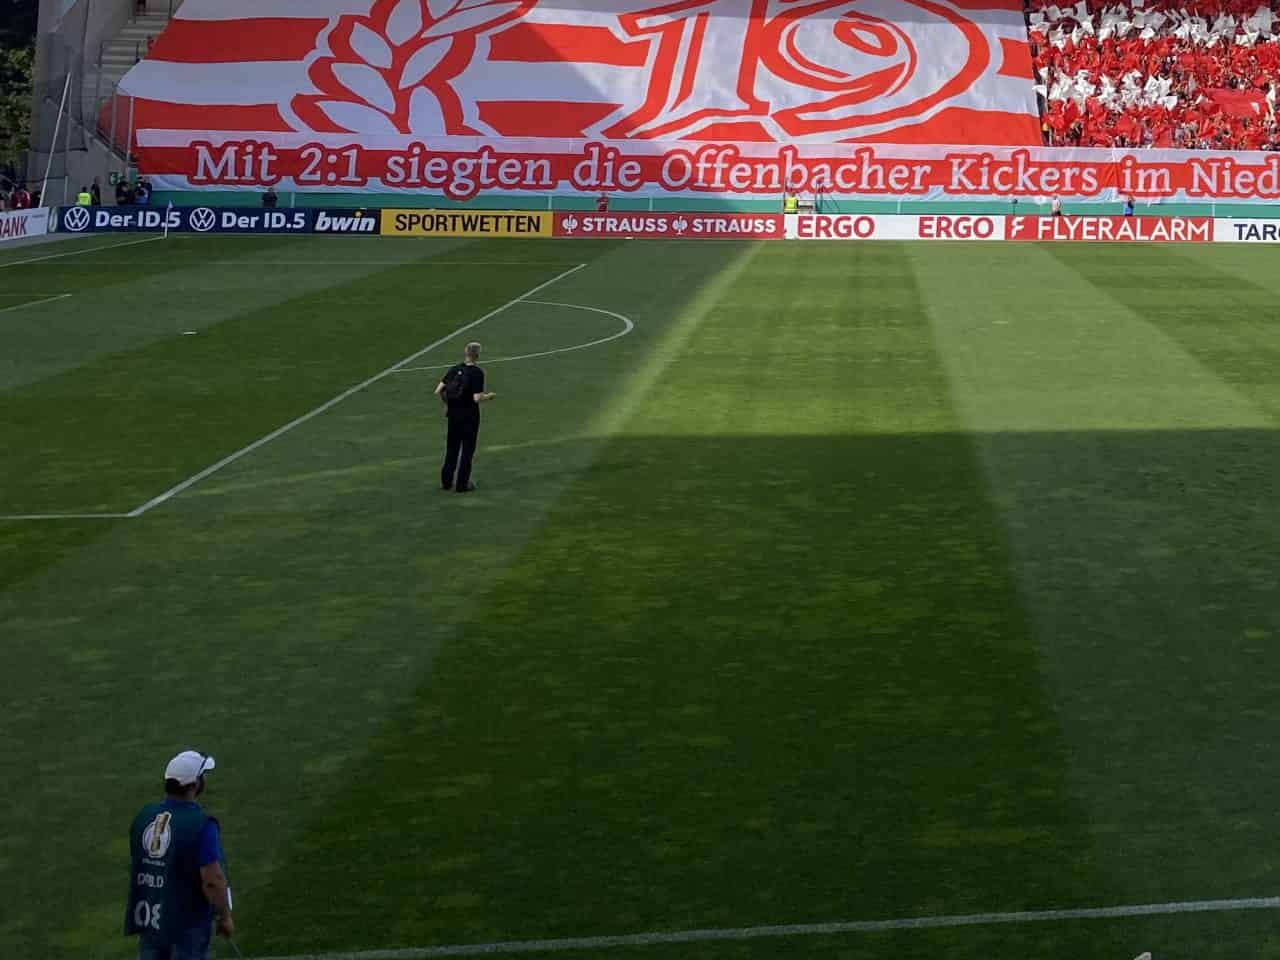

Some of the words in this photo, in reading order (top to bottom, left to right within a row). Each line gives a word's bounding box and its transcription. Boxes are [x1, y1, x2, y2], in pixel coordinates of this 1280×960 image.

[193, 144, 277, 181] Mit
[300, 147, 363, 182] 2:1
[386, 146, 553, 197] siegten
[573, 145, 641, 189] die
[662, 146, 930, 191] Offenbacher
[950, 152, 1098, 192] Kickers
[1123, 159, 1173, 193] im
[95, 211, 130, 229] Der
[137, 211, 181, 229] ID.5
[221, 212, 257, 229] Der
[264, 212, 305, 229] ID.5
[314, 211, 375, 231] bwin
[394, 213, 541, 233] SPORTWETTEN
[582, 216, 668, 233] STRAUSS
[691, 217, 777, 234] STRAUSS
[799, 216, 875, 238] ERGO
[918, 216, 994, 238] ERGO
[1038, 219, 1209, 241] FLYERALARM
